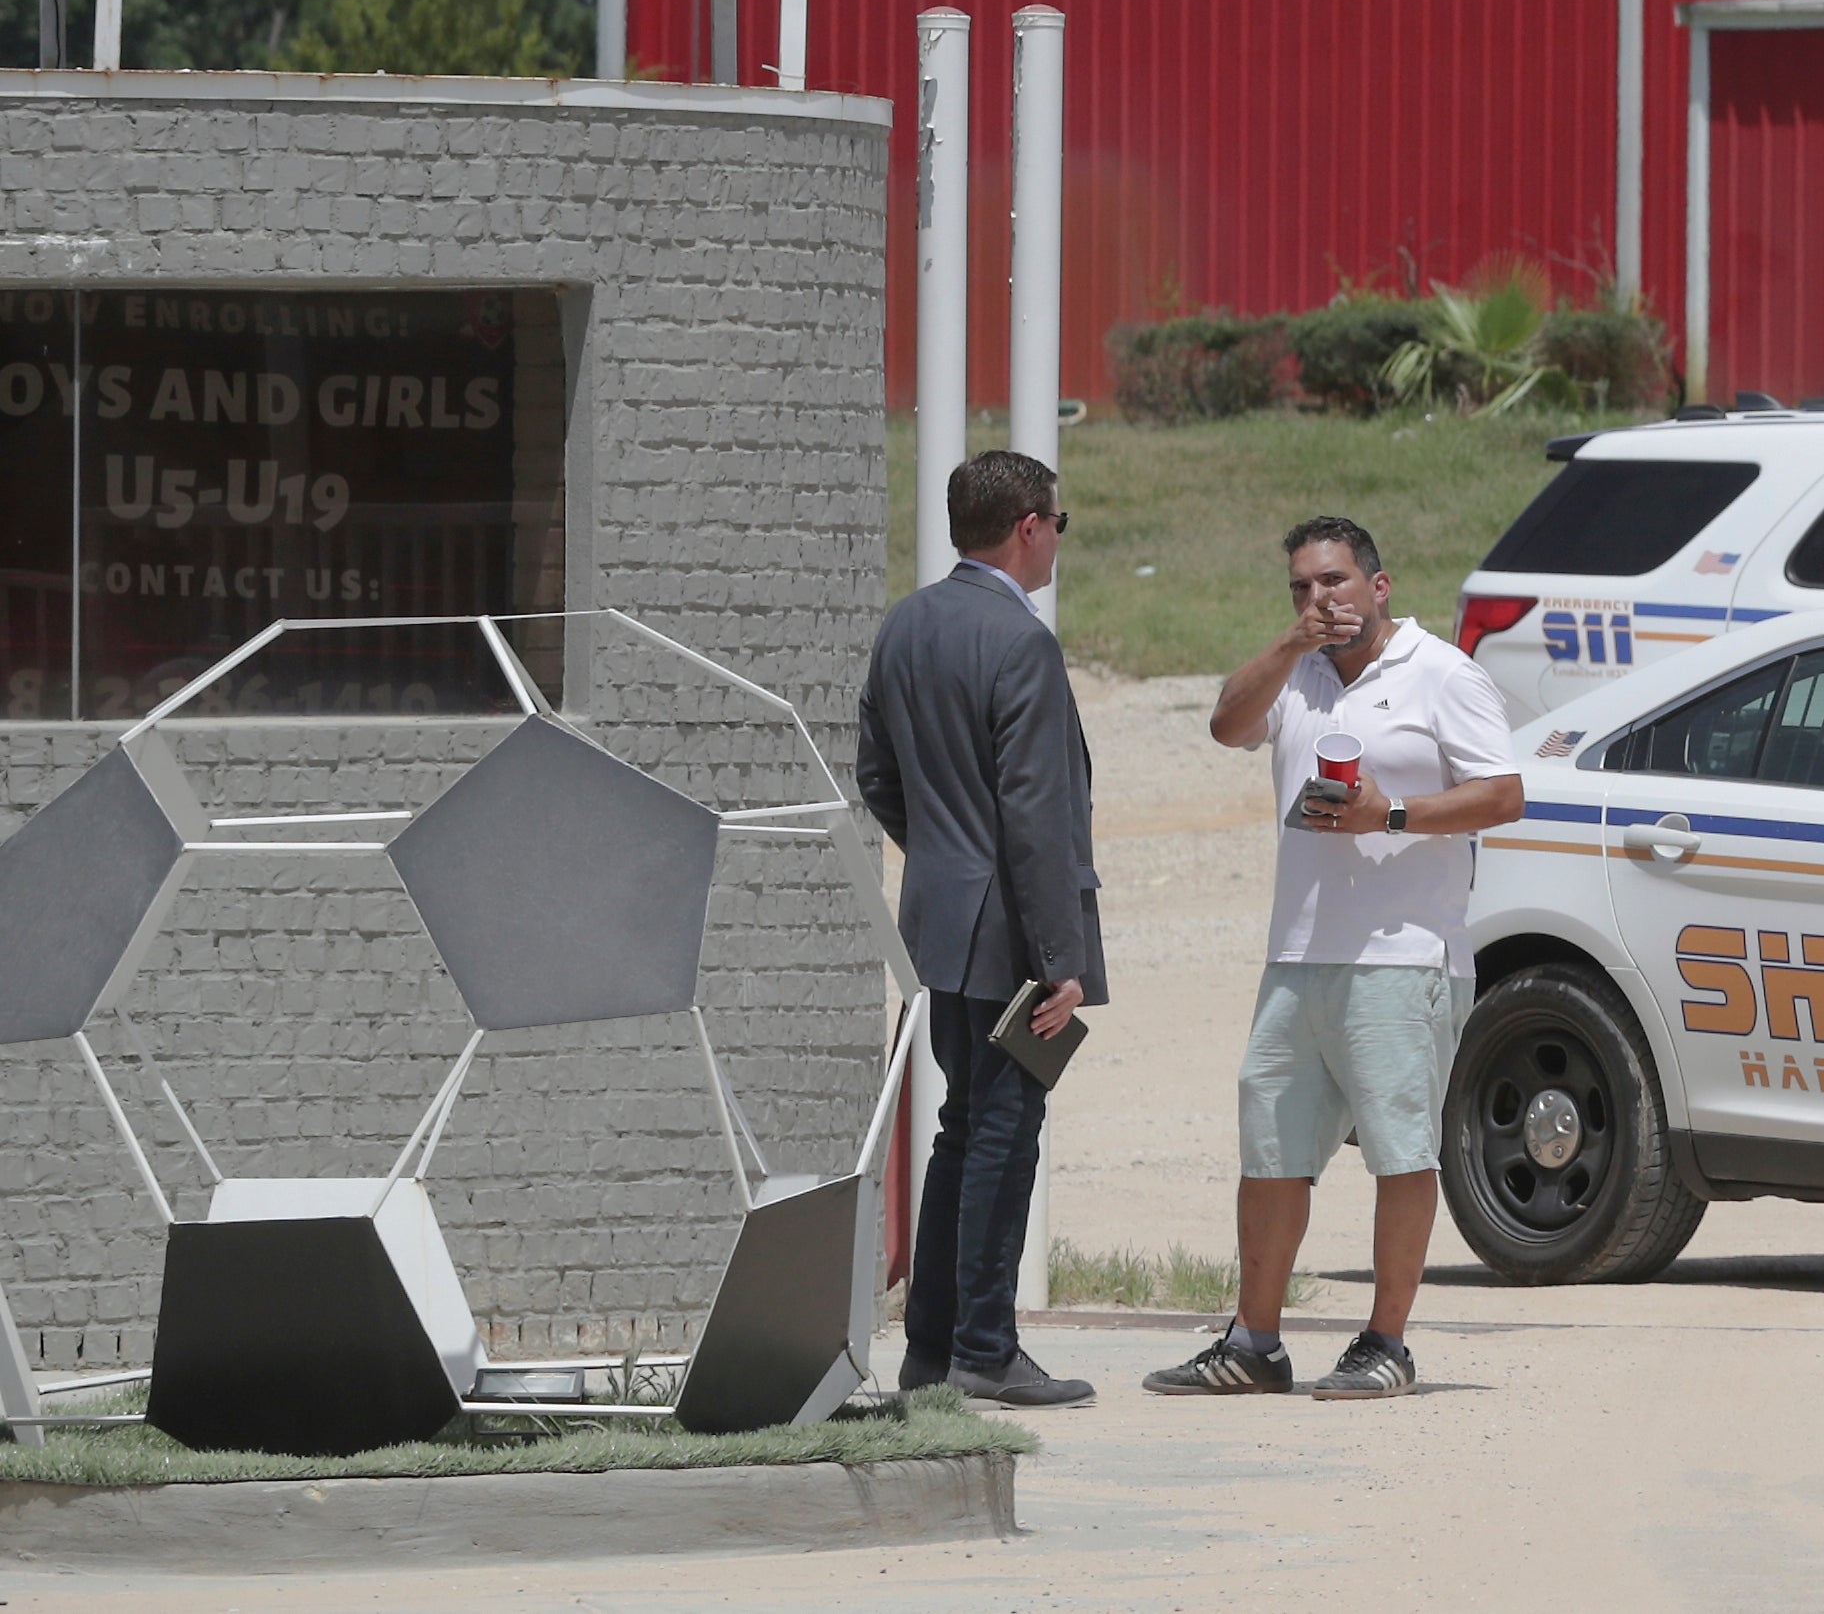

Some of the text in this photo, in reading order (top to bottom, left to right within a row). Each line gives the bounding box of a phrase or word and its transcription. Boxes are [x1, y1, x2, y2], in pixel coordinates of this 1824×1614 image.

[0, 362, 501, 429] OYS AND GIRLS
[105, 454, 350, 533] U5-U19
[79, 560, 380, 602] CONTACT US:
[1543, 597, 1630, 611] EMERGENCY
[1542, 612, 1633, 665] 911
